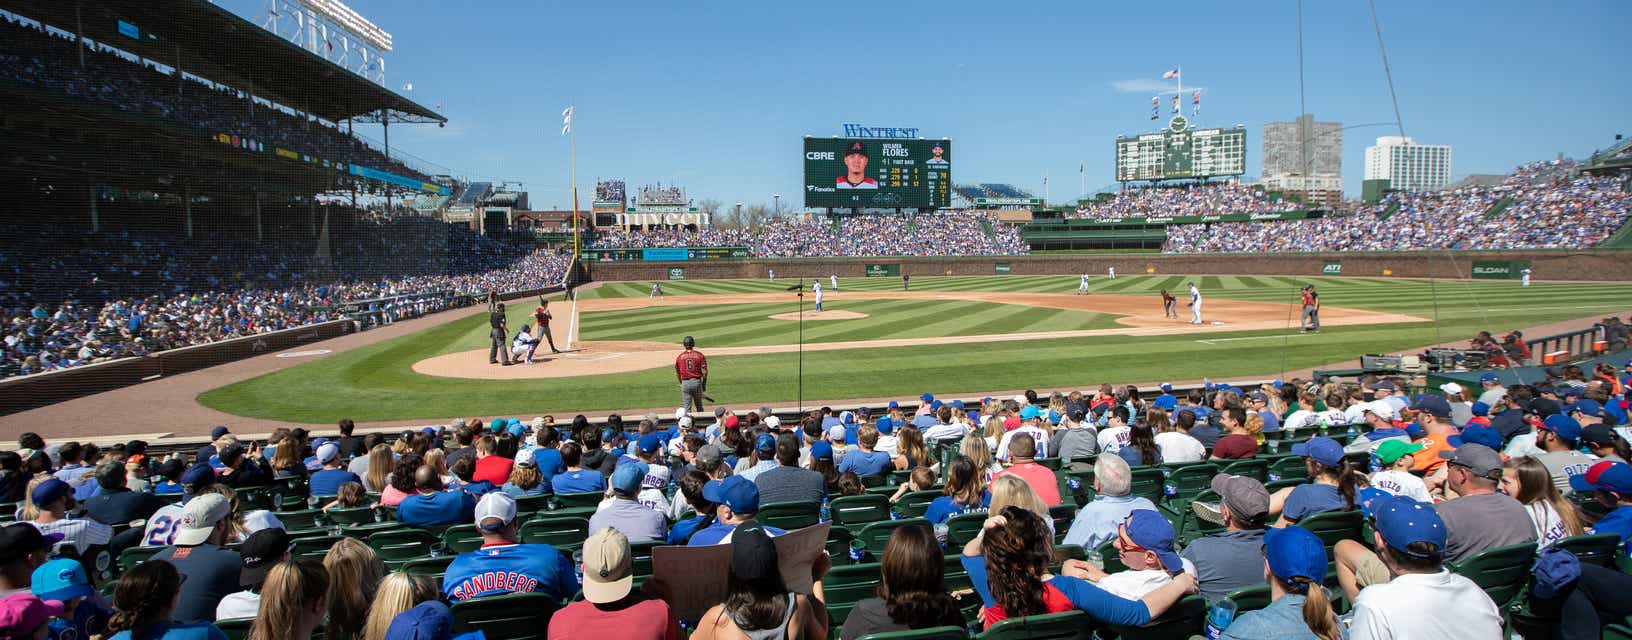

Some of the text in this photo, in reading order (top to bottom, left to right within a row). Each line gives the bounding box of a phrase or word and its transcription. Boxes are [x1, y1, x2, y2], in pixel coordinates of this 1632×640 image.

[843, 124, 920, 138] WINTRUST
[806, 152, 835, 160] CBRE
[883, 149, 909, 157] FLORES
[686, 359, 694, 371] 6
[1378, 480, 1401, 492] RIZZO
[453, 571, 538, 600] SANDBERG
